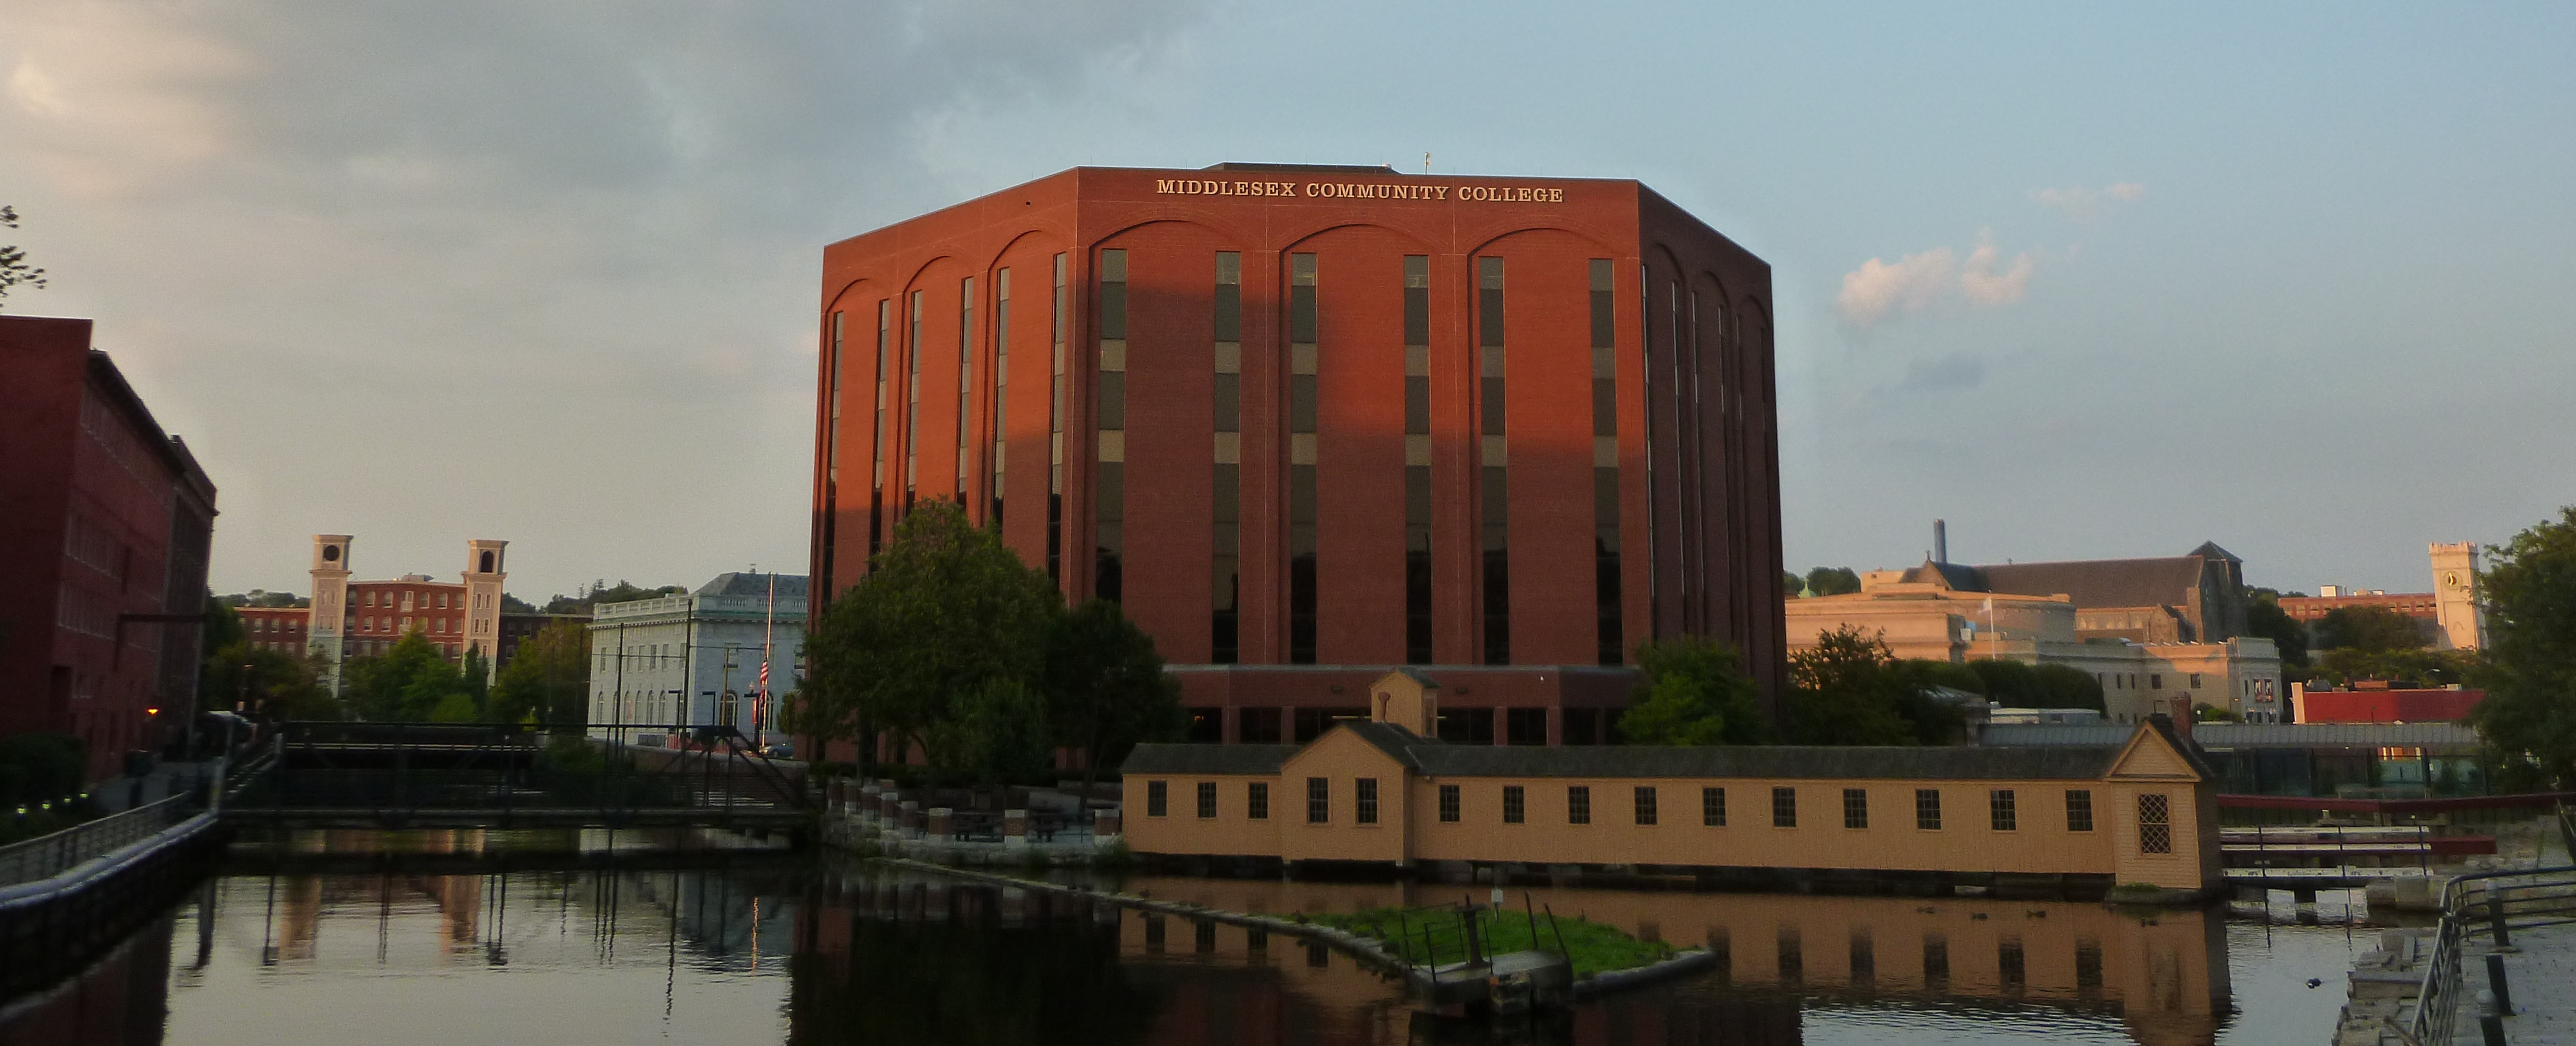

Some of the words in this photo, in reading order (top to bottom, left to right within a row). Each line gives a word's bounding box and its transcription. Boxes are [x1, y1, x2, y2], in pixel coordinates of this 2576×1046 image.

[1157, 179, 1297, 197] MIDDLESEX
[1306, 182, 1449, 200] COMMUNITY
[1458, 186, 1563, 202] COLLEGE
